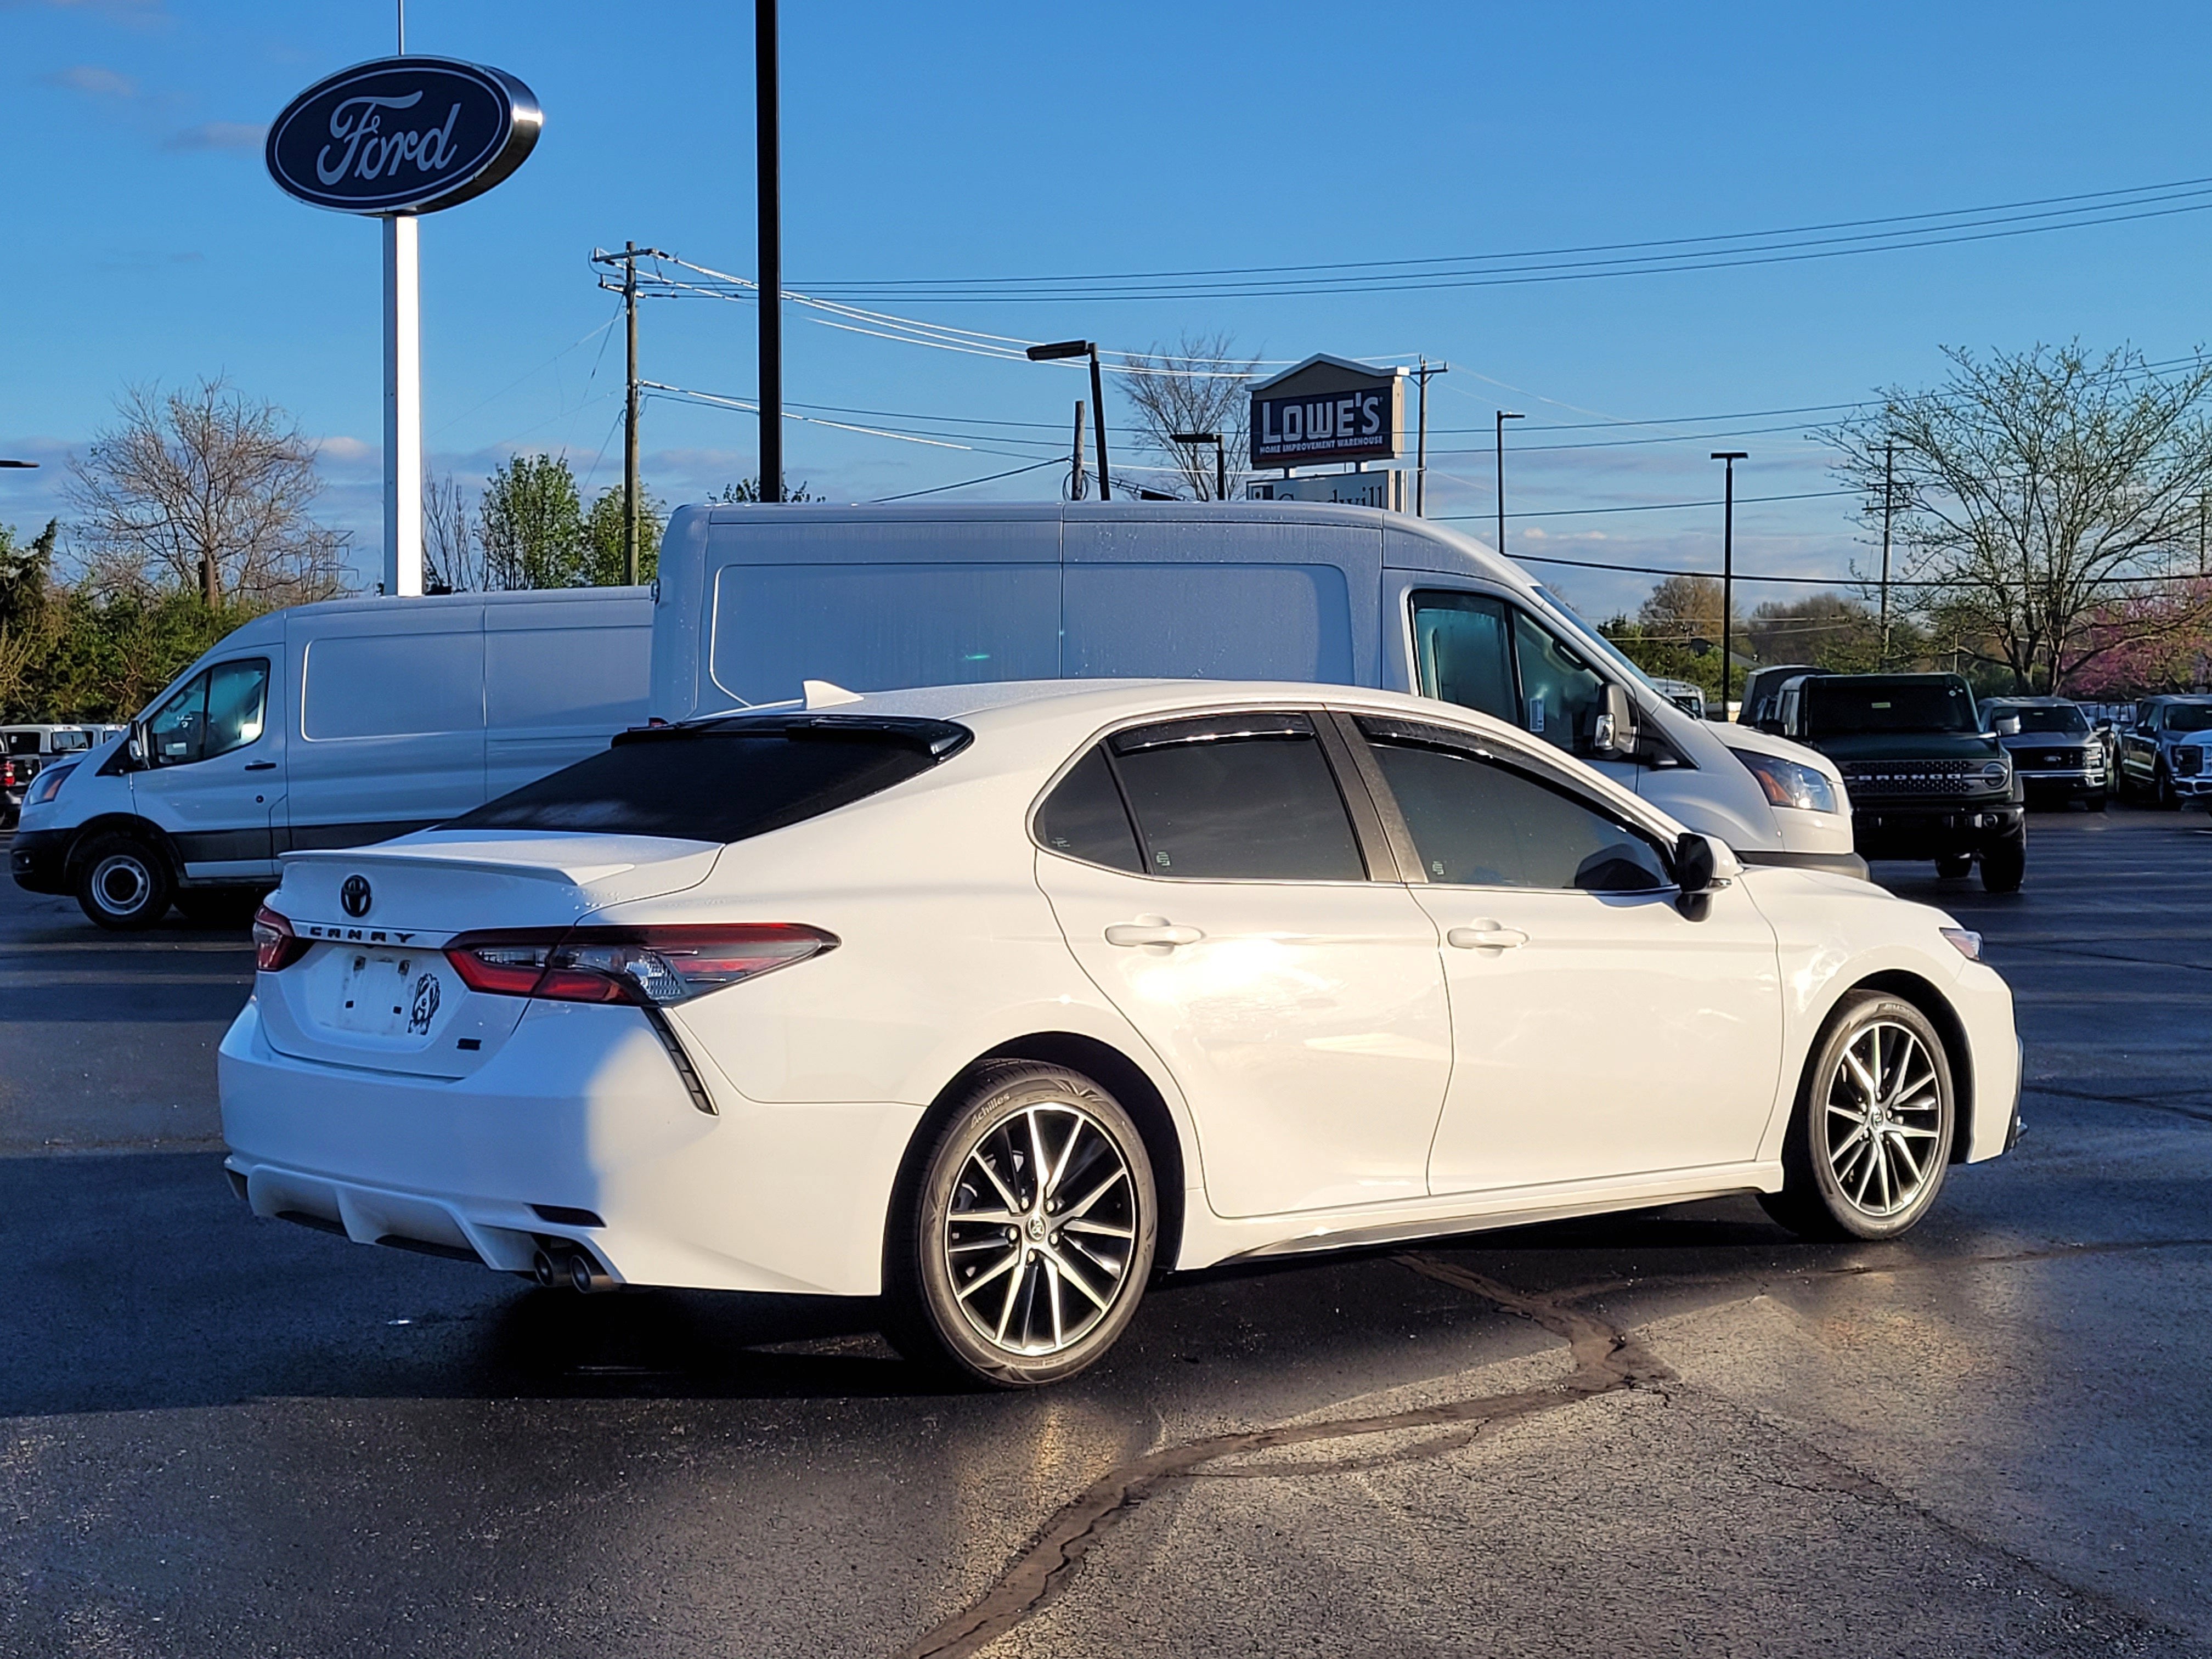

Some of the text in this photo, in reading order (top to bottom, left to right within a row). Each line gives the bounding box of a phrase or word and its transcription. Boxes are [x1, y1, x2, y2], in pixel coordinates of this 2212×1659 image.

[317, 90, 461, 185] Ford
[1263, 392, 1380, 444] LOWE'S
[1260, 435, 1384, 455] HOME IMPROVEMENT WAREHOUSE
[1858, 773, 1961, 781] BRONCO
[970, 1092, 1011, 1130] Achilles
